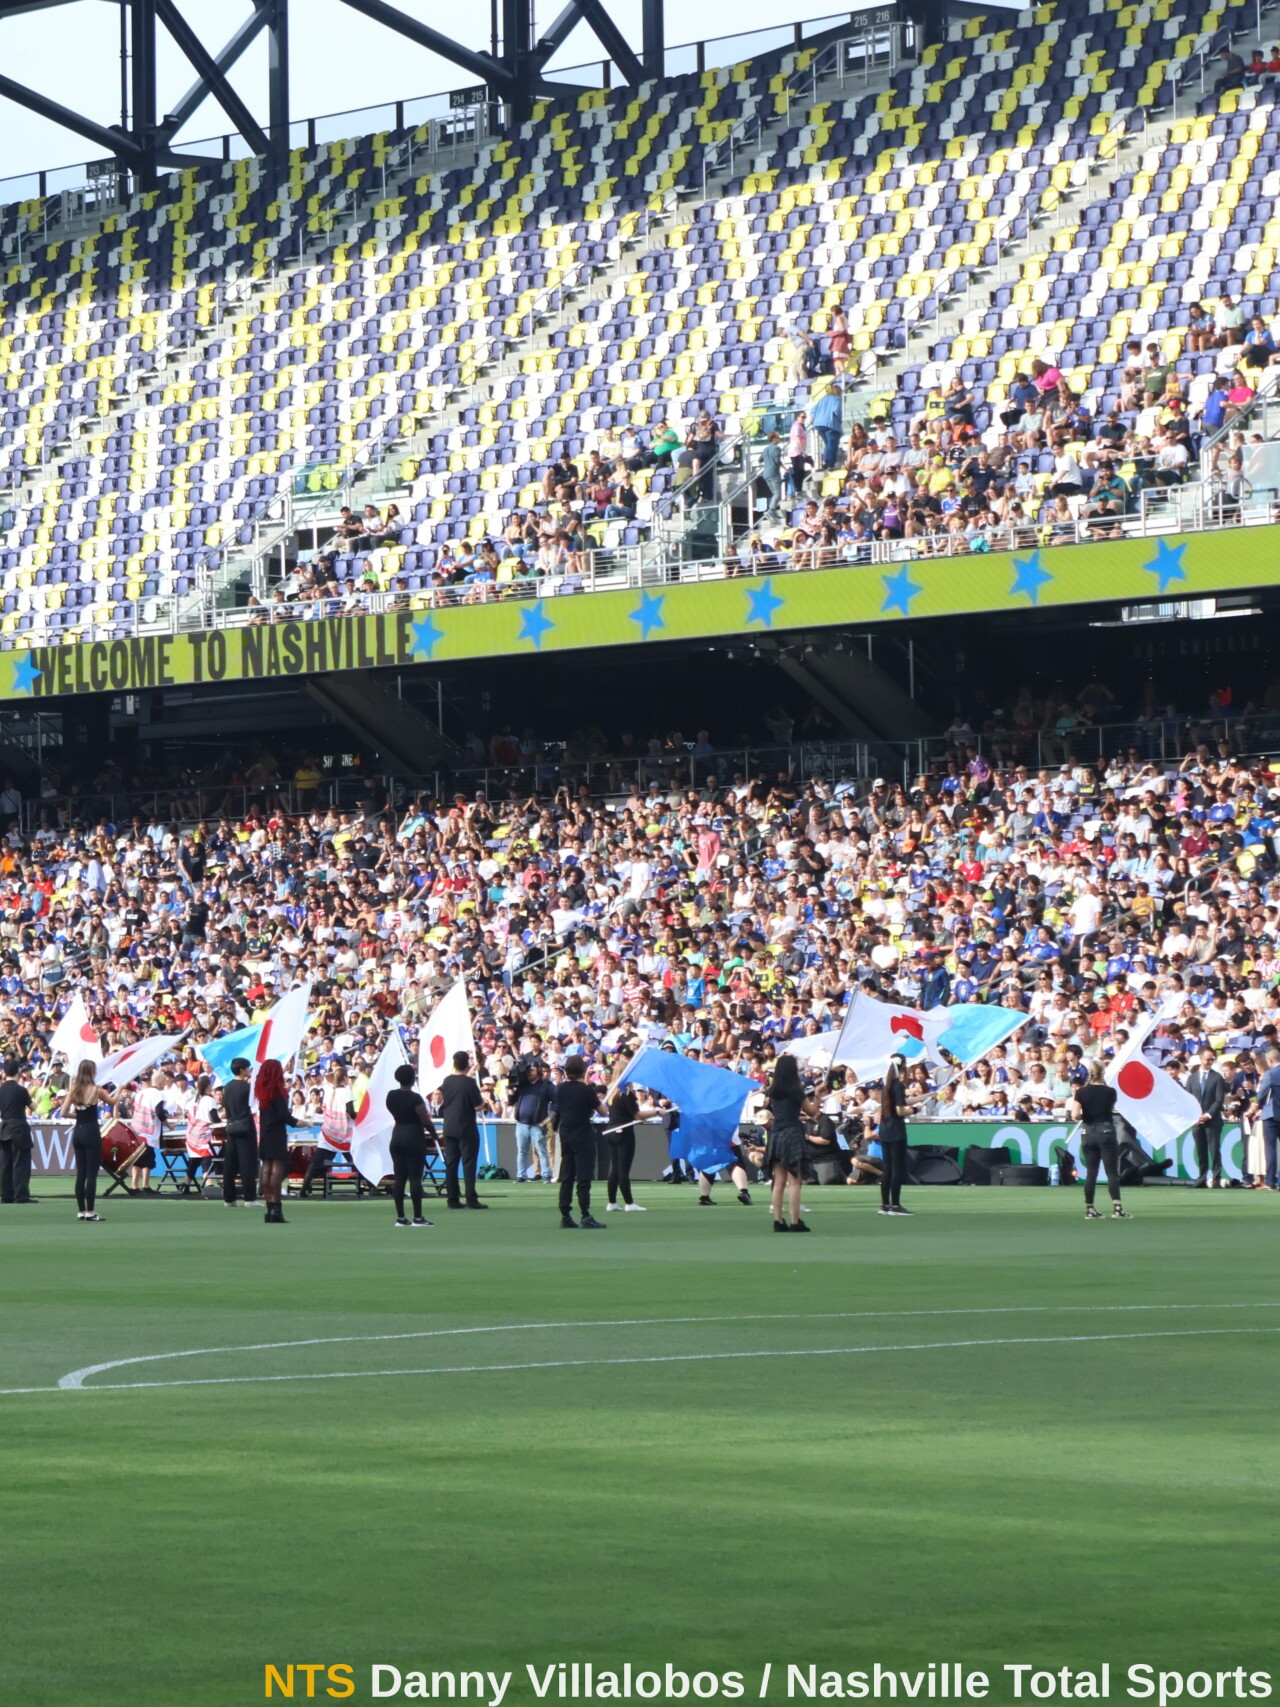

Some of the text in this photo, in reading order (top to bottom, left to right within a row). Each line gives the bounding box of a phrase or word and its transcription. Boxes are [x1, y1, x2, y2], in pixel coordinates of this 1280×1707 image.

[875, 9, 890, 23] 216
[30, 612, 415, 696] WELCOME TO NASHVILLE
